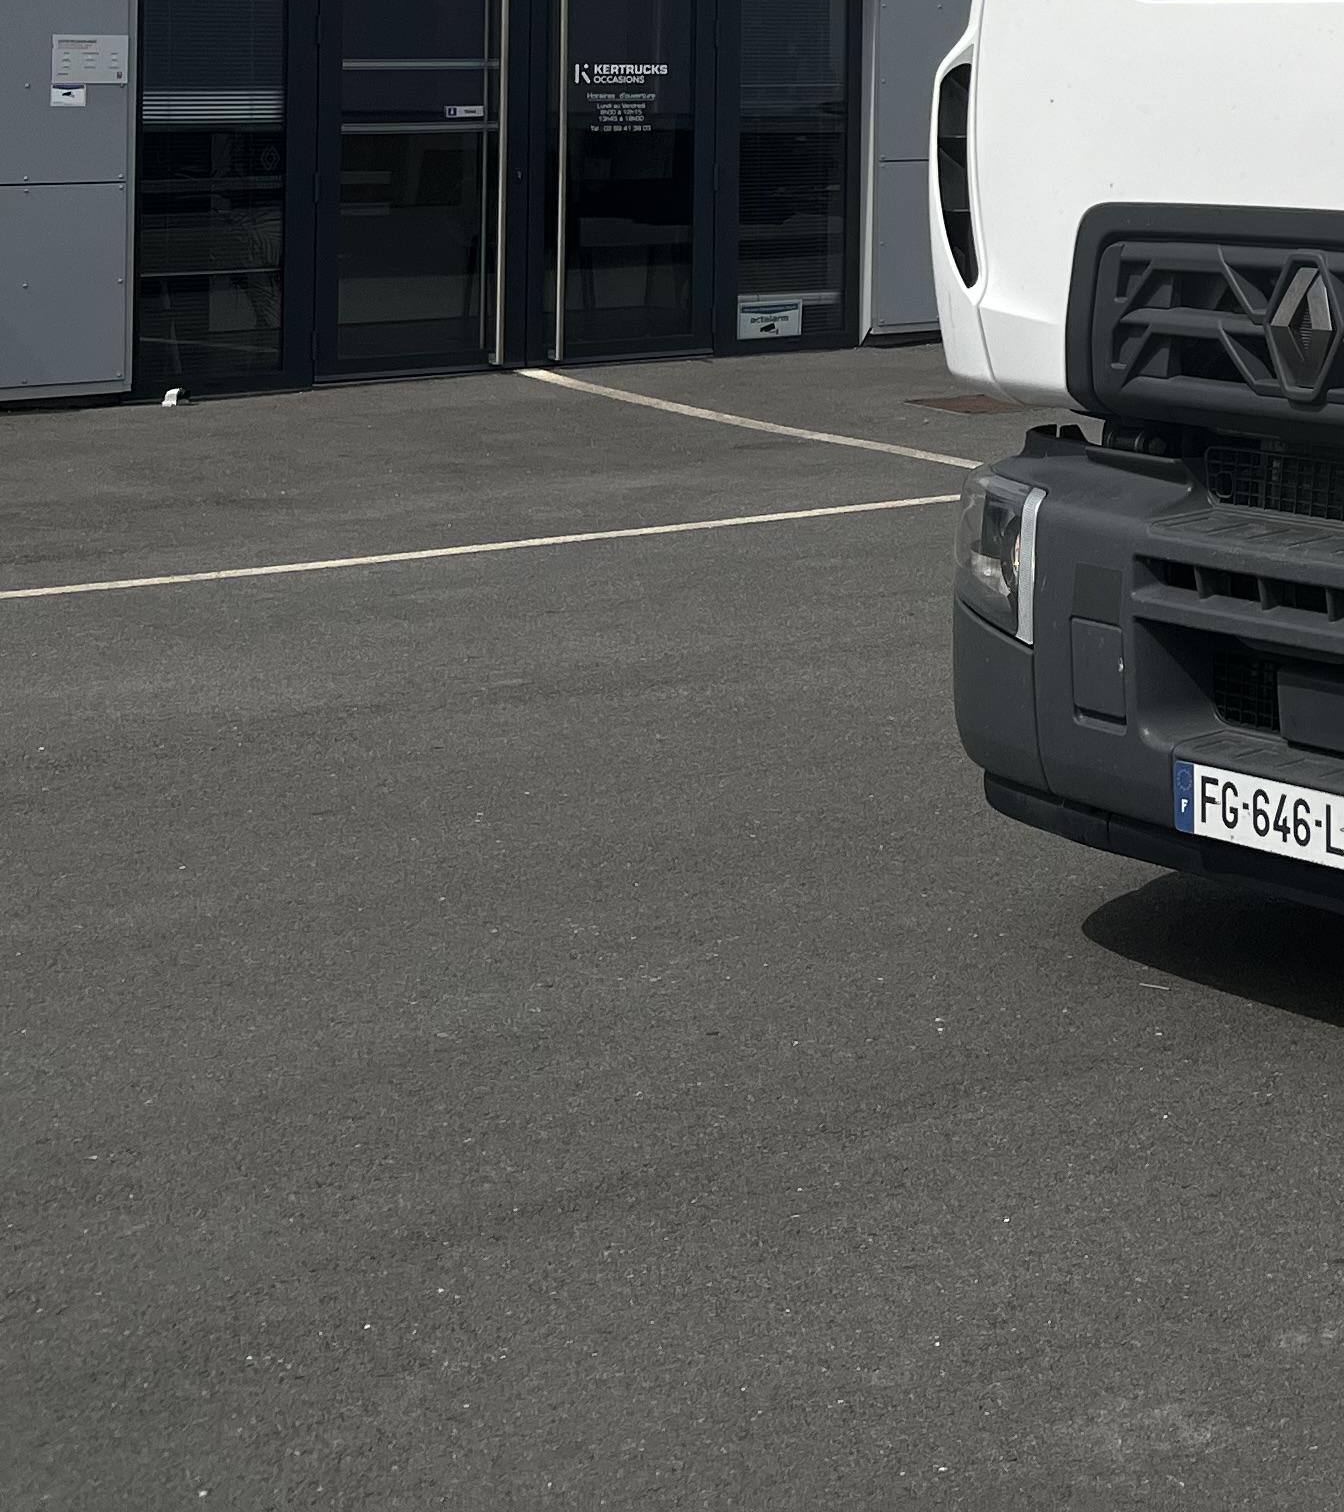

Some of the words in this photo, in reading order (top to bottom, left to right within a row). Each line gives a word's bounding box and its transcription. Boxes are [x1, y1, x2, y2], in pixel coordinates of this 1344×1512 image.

[594, 64, 668, 75] KERTRUCKS
[593, 75, 645, 84] OCCASIONS
[1180, 798, 1188, 813] F
